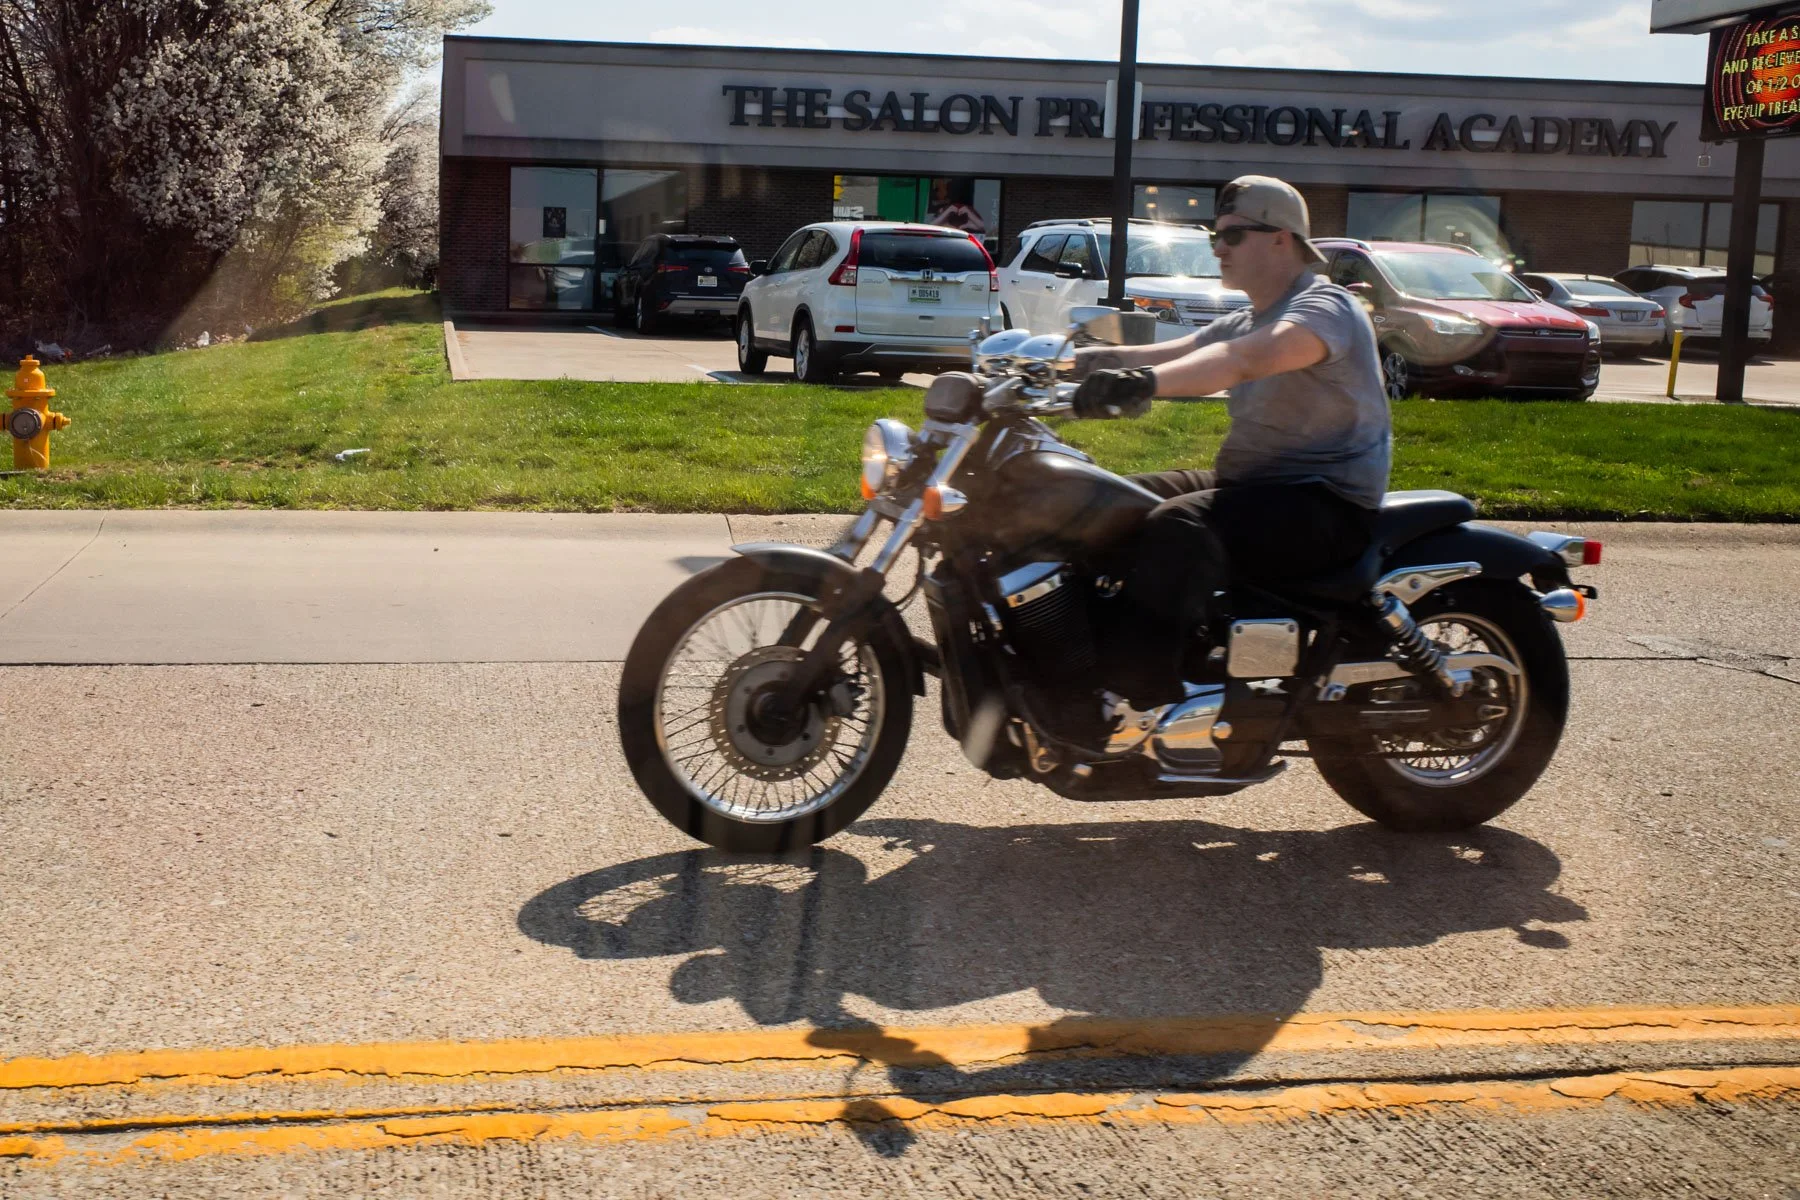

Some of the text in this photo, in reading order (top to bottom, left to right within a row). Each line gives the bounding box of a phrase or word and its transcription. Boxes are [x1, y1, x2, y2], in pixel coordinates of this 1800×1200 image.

[1746, 25, 1800, 47] TAKE A S
[1722, 59, 1749, 75] AND
[1746, 79, 1763, 94] OR
[1768, 76, 1788, 93] 1/2
[722, 84, 1678, 159] THE SALON PRFESSIONAL ACADEMY
